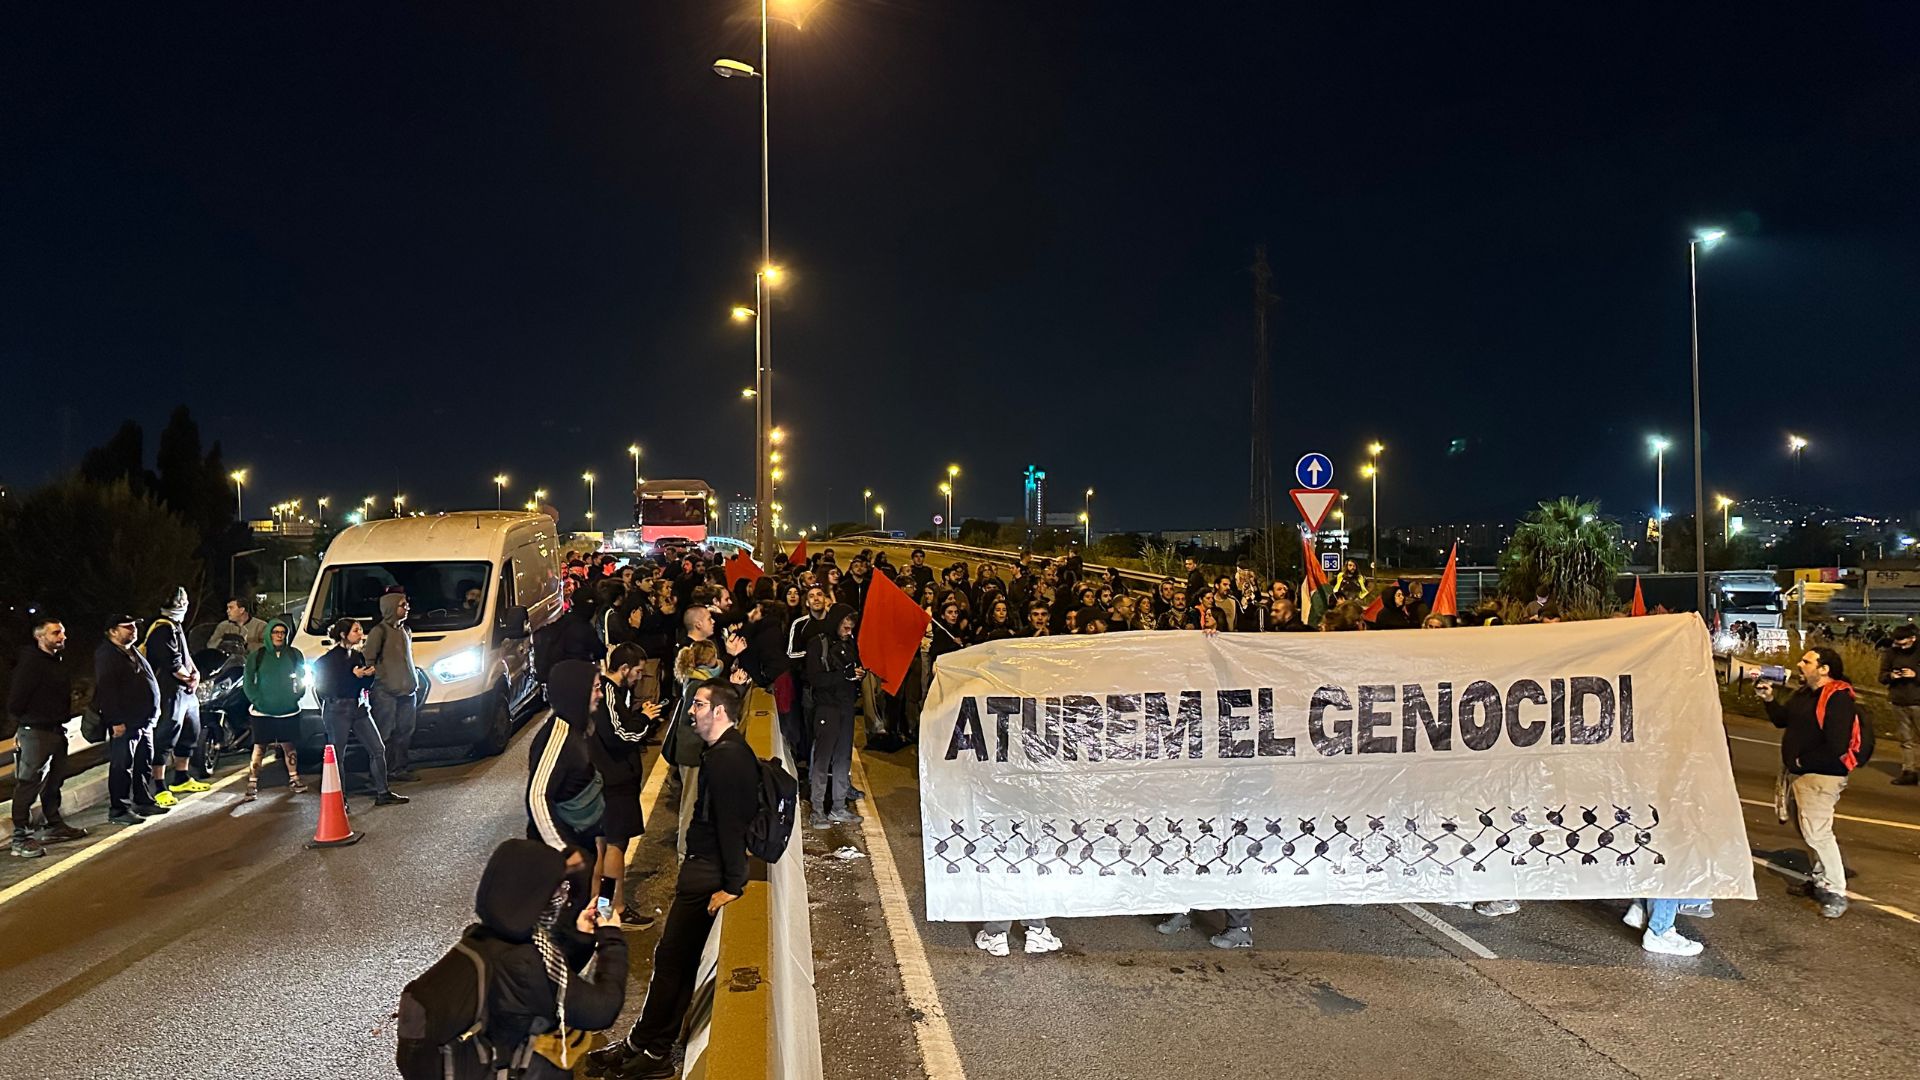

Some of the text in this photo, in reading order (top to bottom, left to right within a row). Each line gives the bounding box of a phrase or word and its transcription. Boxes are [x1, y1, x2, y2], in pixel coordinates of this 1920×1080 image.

[945, 675, 1635, 762] ATUREM EL GENOCIDI
